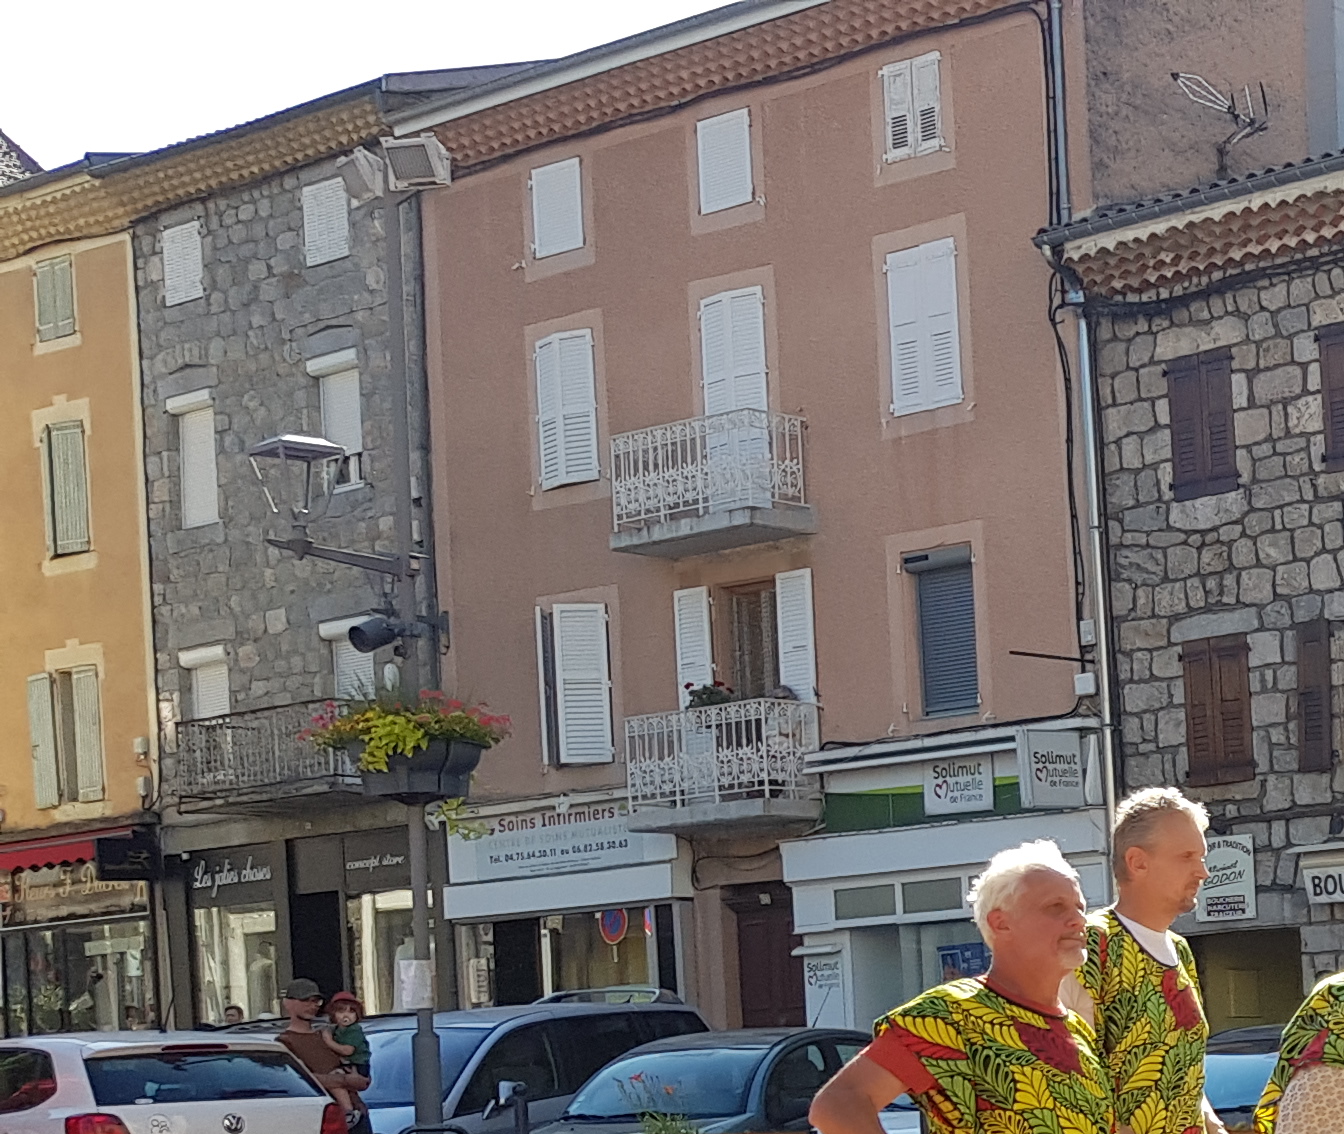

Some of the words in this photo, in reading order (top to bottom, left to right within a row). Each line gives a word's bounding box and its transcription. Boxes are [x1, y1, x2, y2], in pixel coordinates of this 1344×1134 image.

[1033, 751, 1078, 765] Solimut
[932, 762, 982, 780] Solimut
[498, 816, 536, 833] Soins
[346, 856, 380, 872] concept
[381, 854, 405, 866] store
[193, 859, 211, 889] Les
[211, 858, 239, 899] jolies
[240, 855, 271, 883] choses
[1203, 869, 1246, 886] GODON
